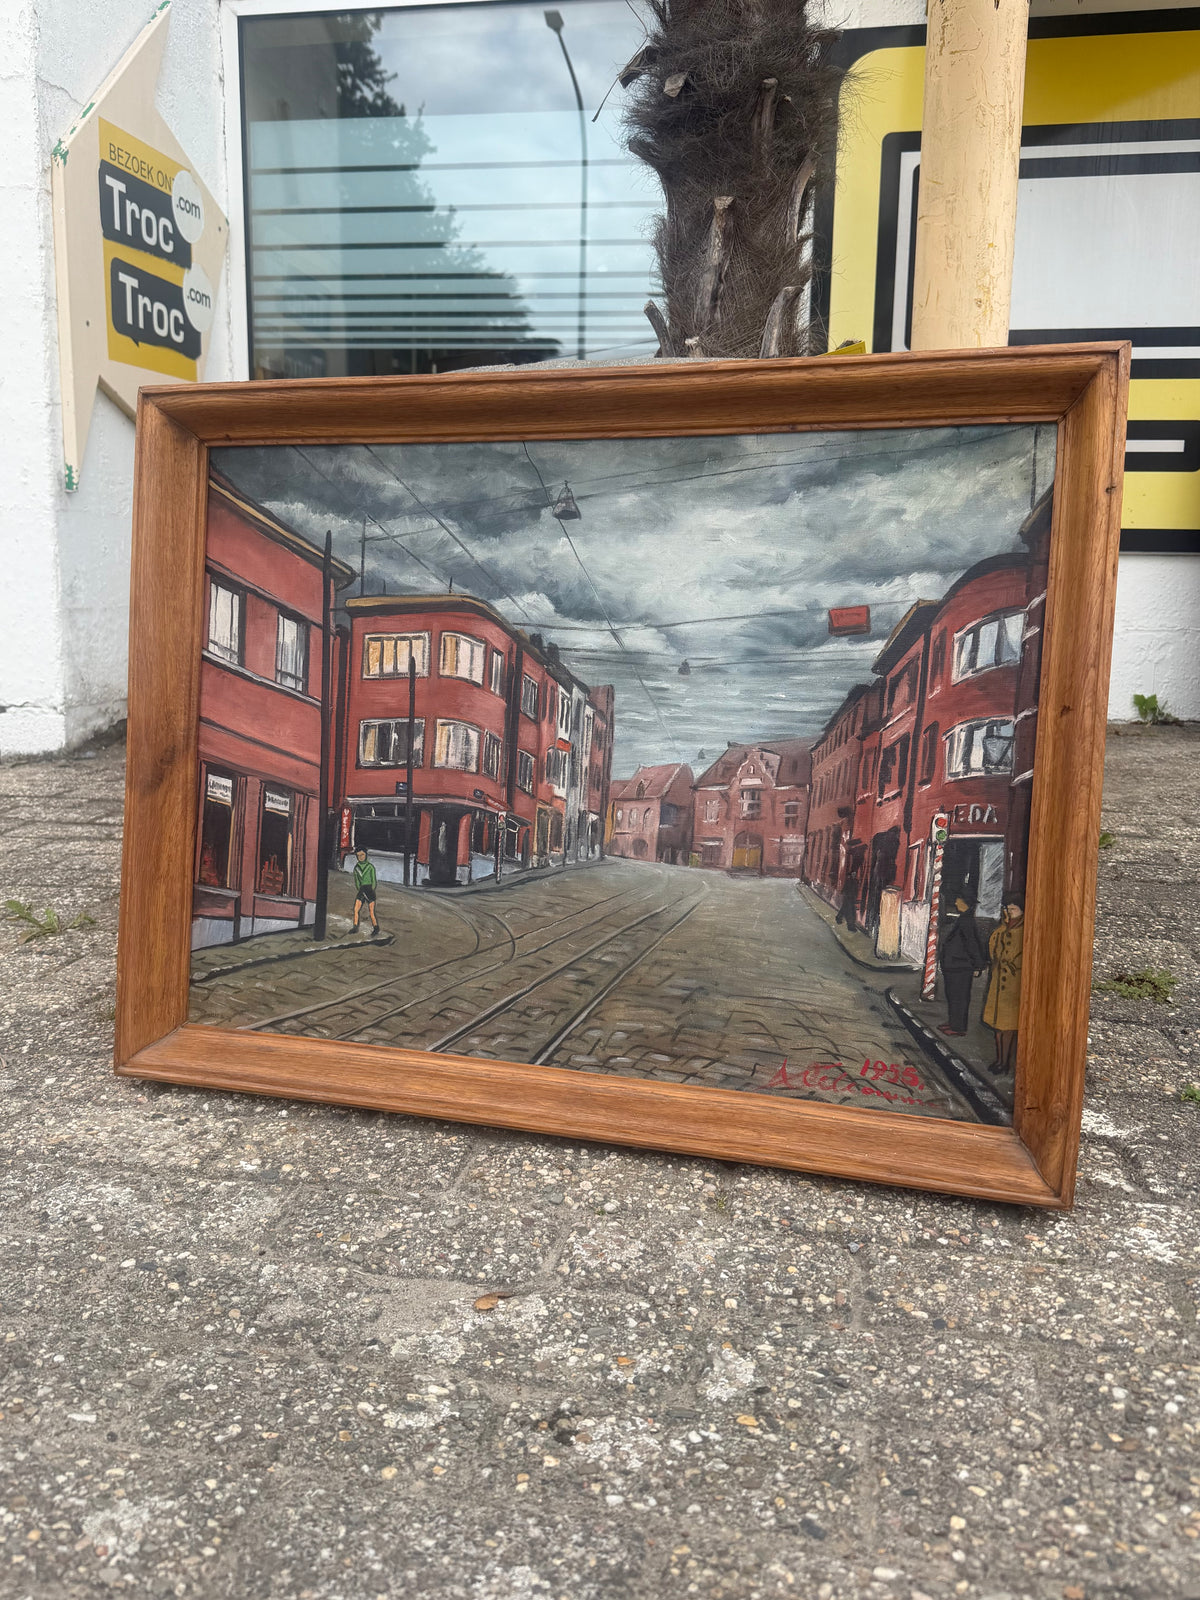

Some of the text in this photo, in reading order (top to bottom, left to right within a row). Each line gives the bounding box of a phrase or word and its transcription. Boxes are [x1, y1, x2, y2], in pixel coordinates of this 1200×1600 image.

[109, 142, 175, 193] BEZOEK ON
[105, 174, 201, 253] Troc .com
[118, 271, 211, 343] Troc .com
